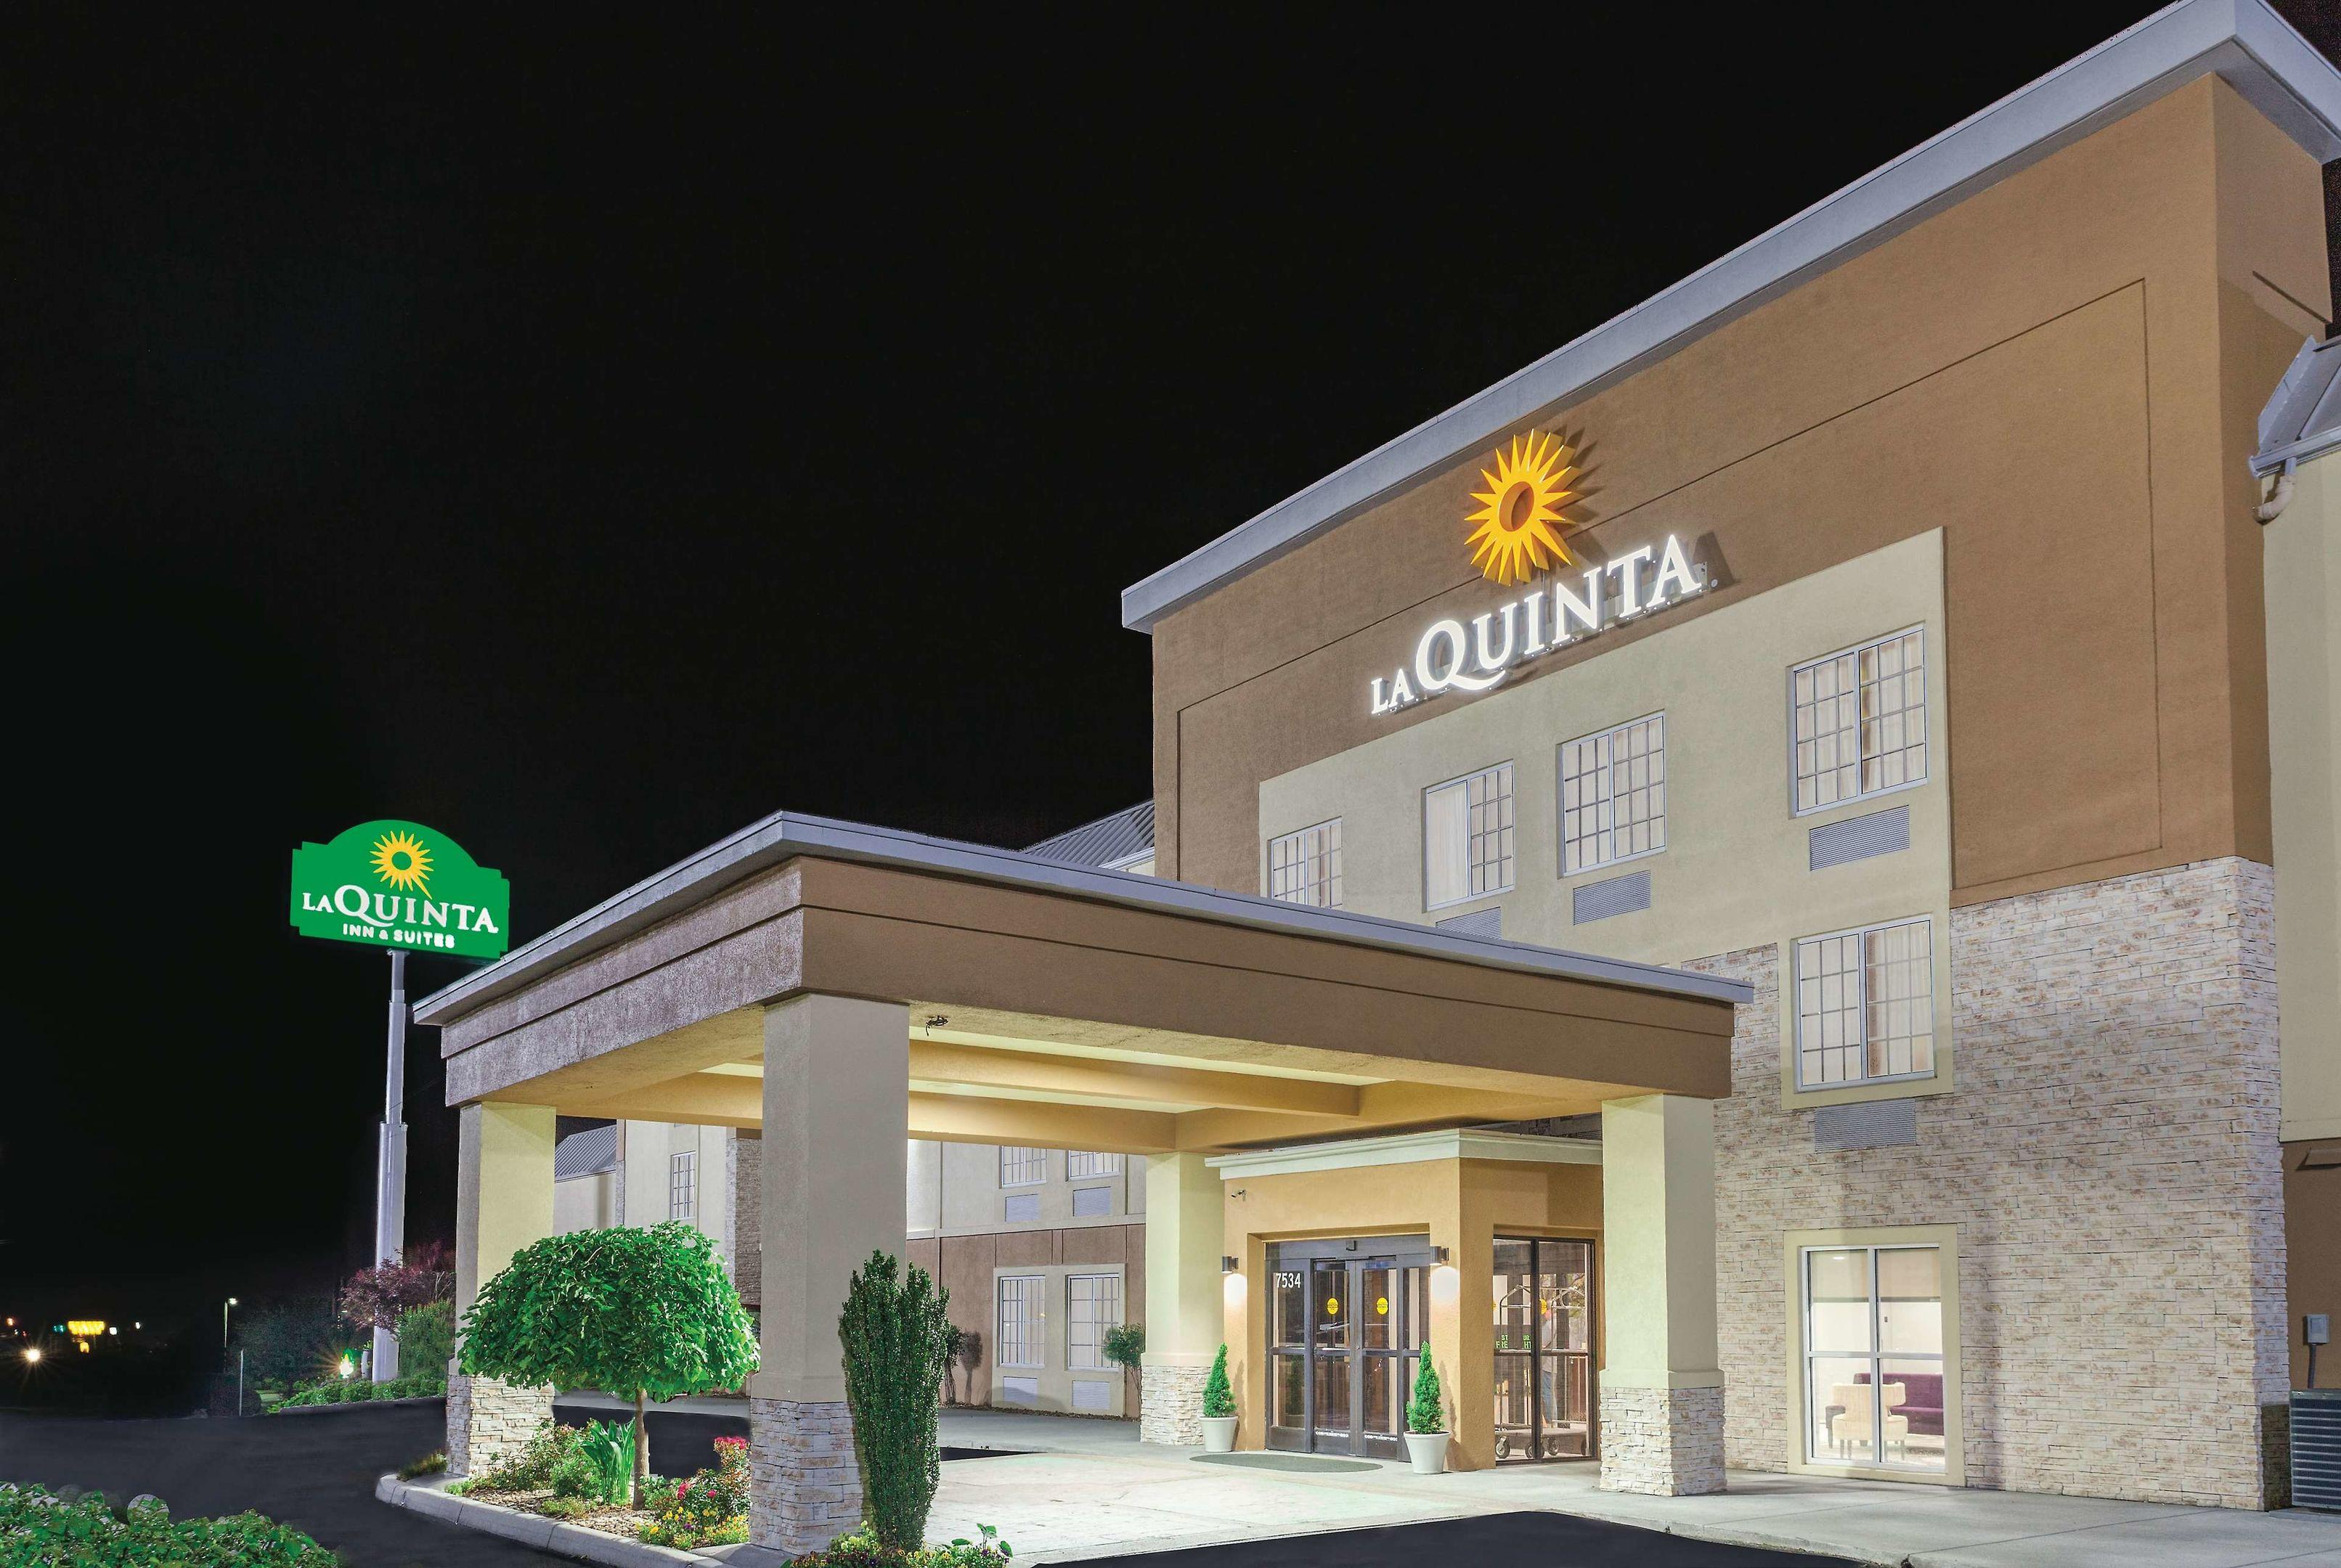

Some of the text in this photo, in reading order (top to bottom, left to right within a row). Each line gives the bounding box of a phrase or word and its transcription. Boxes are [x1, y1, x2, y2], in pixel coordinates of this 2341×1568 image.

[1370, 534, 1702, 714] LA QUINTA
[302, 884, 499, 934] LA QUINTA
[343, 923, 455, 949] INN & SUITES
[1276, 1273, 1301, 1289] 7534
